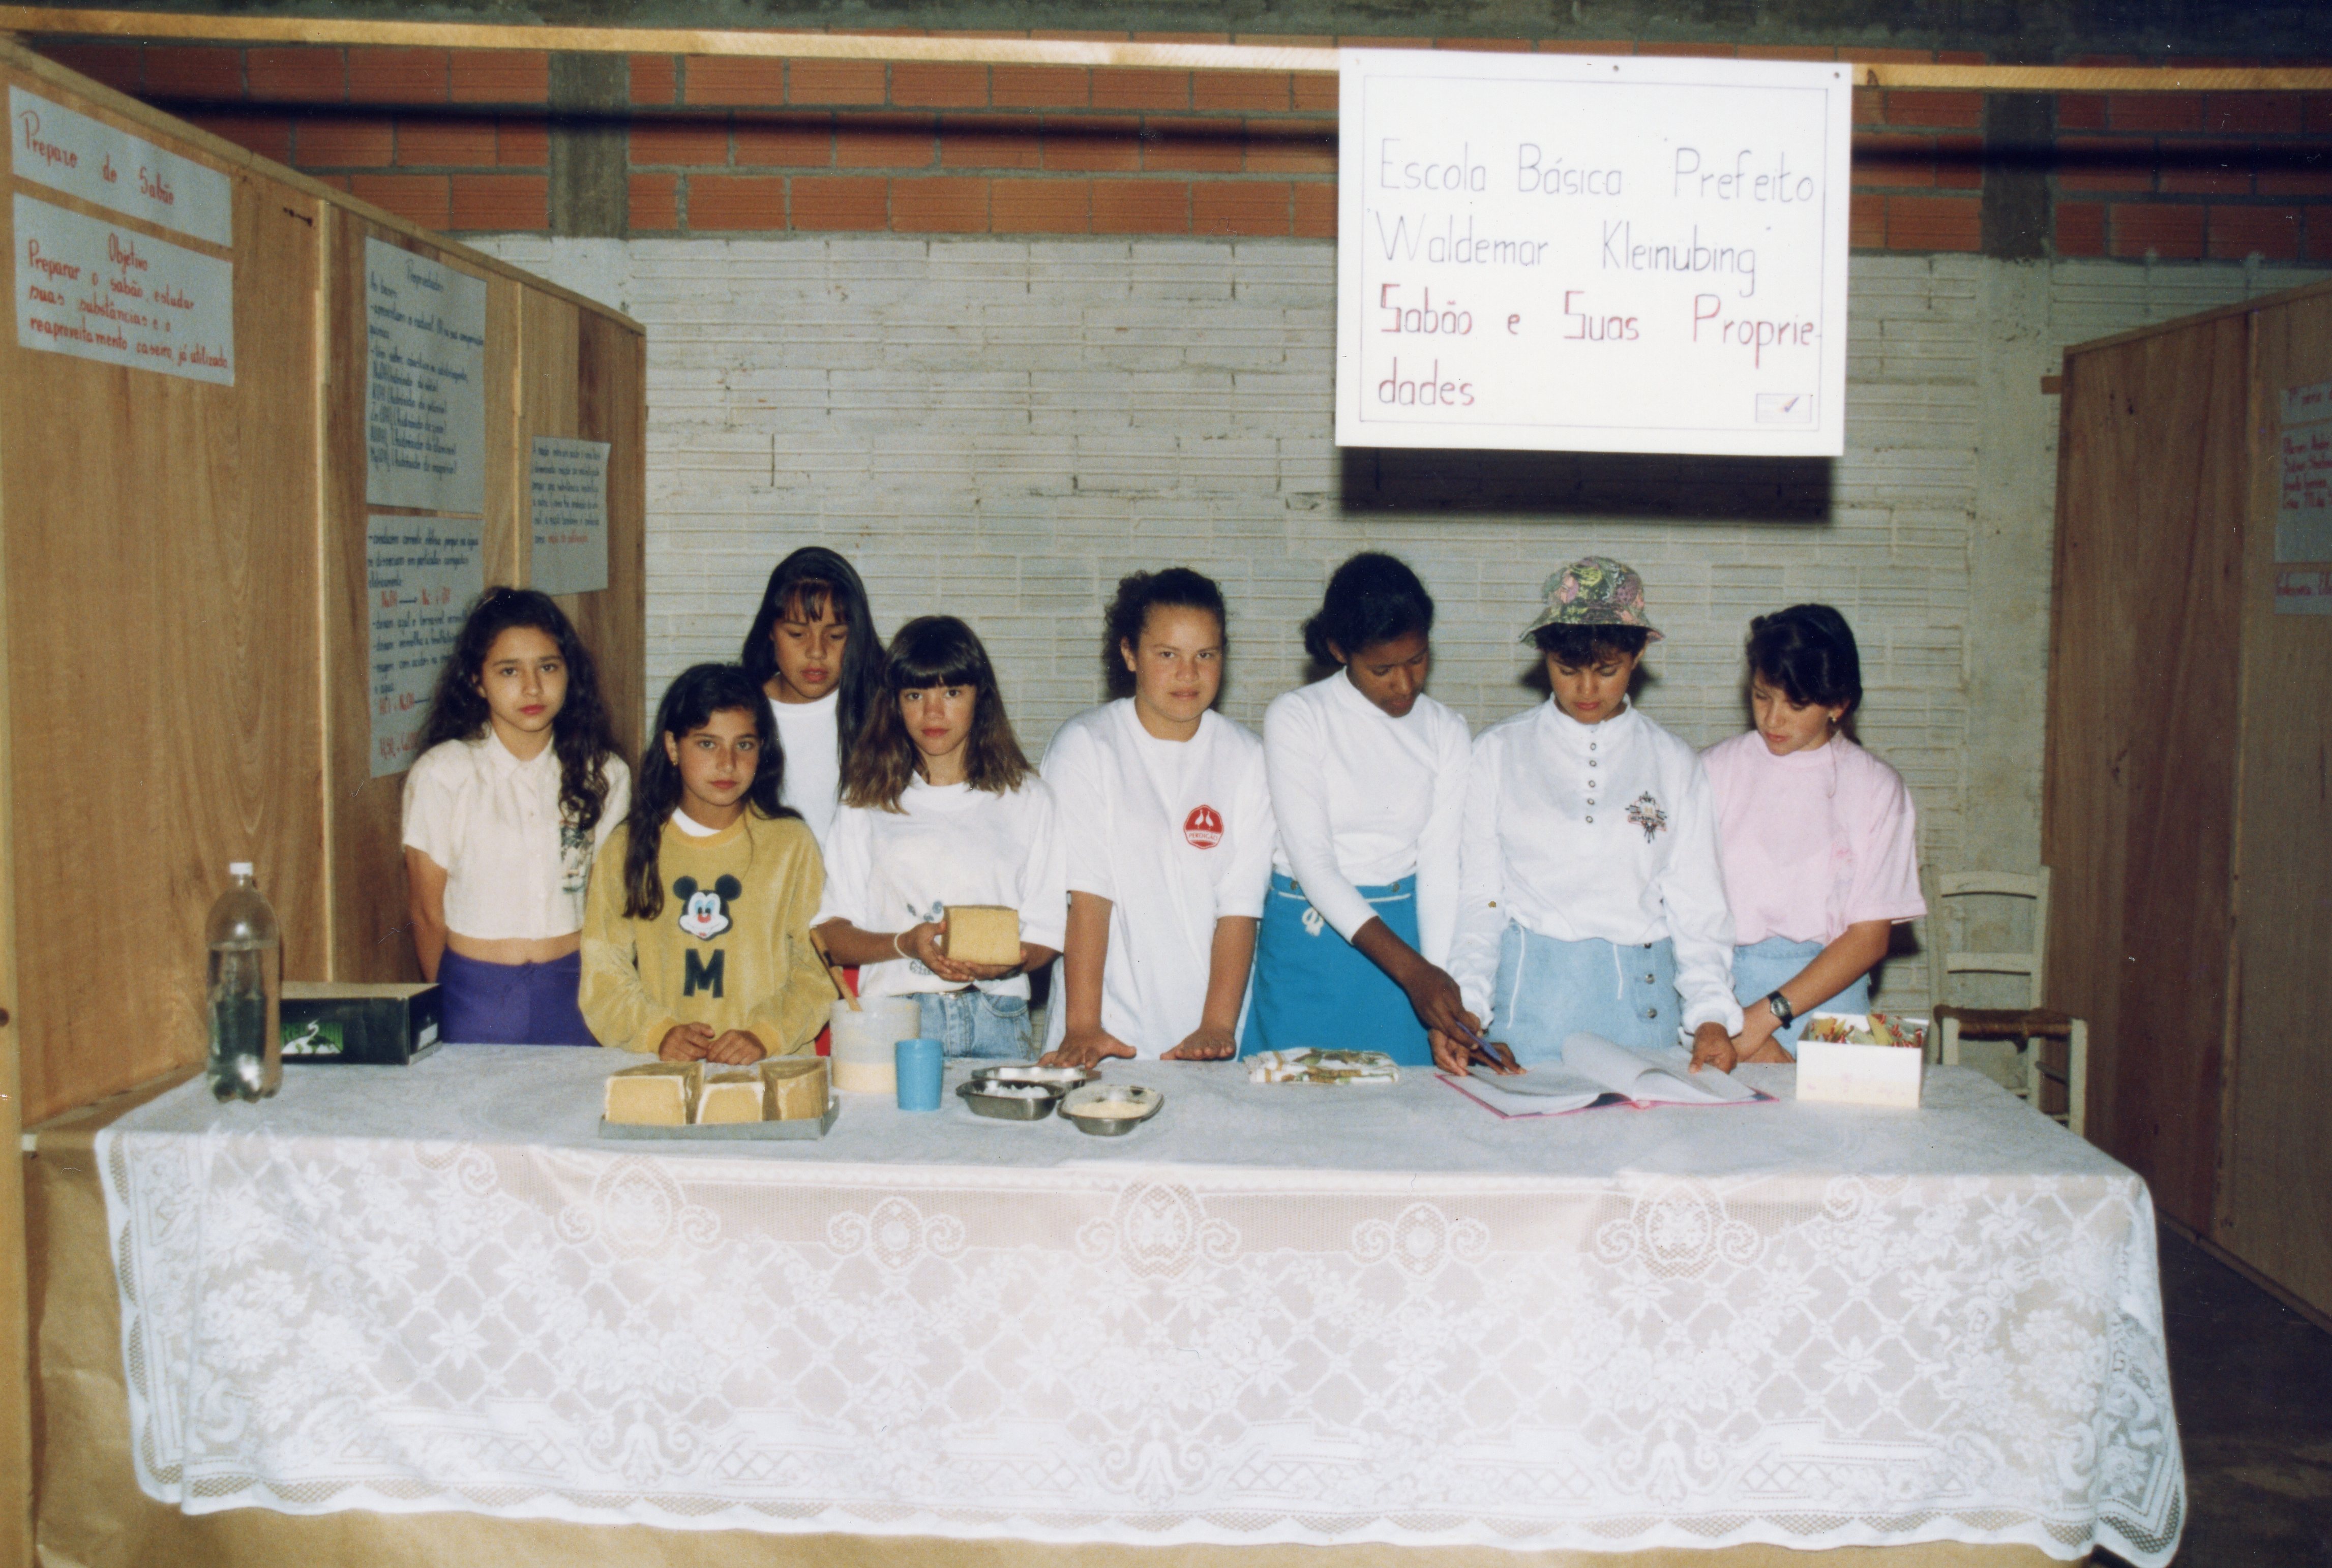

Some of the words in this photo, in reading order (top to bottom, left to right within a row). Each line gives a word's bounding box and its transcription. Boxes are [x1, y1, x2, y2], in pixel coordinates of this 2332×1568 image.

[139, 166, 174, 206] Sabão
[1381, 138, 1486, 191] Escola
[1518, 143, 1622, 195] Básica
[1675, 147, 1813, 202] Prefeito
[108, 232, 147, 275] Objetivo
[1376, 210, 1549, 266] Waldemar
[28, 238, 81, 281] Preparar
[92, 272, 99, 286] o
[154, 284, 195, 310] estudar
[29, 285, 65, 306] suas
[153, 318, 159, 331] e
[165, 321, 171, 333] o
[1381, 283, 1473, 335] Sabão
[1507, 313, 1520, 335] e
[1563, 290, 1640, 341] Suas
[1378, 356, 1475, 406] dades
[683, 948, 725, 998] M
